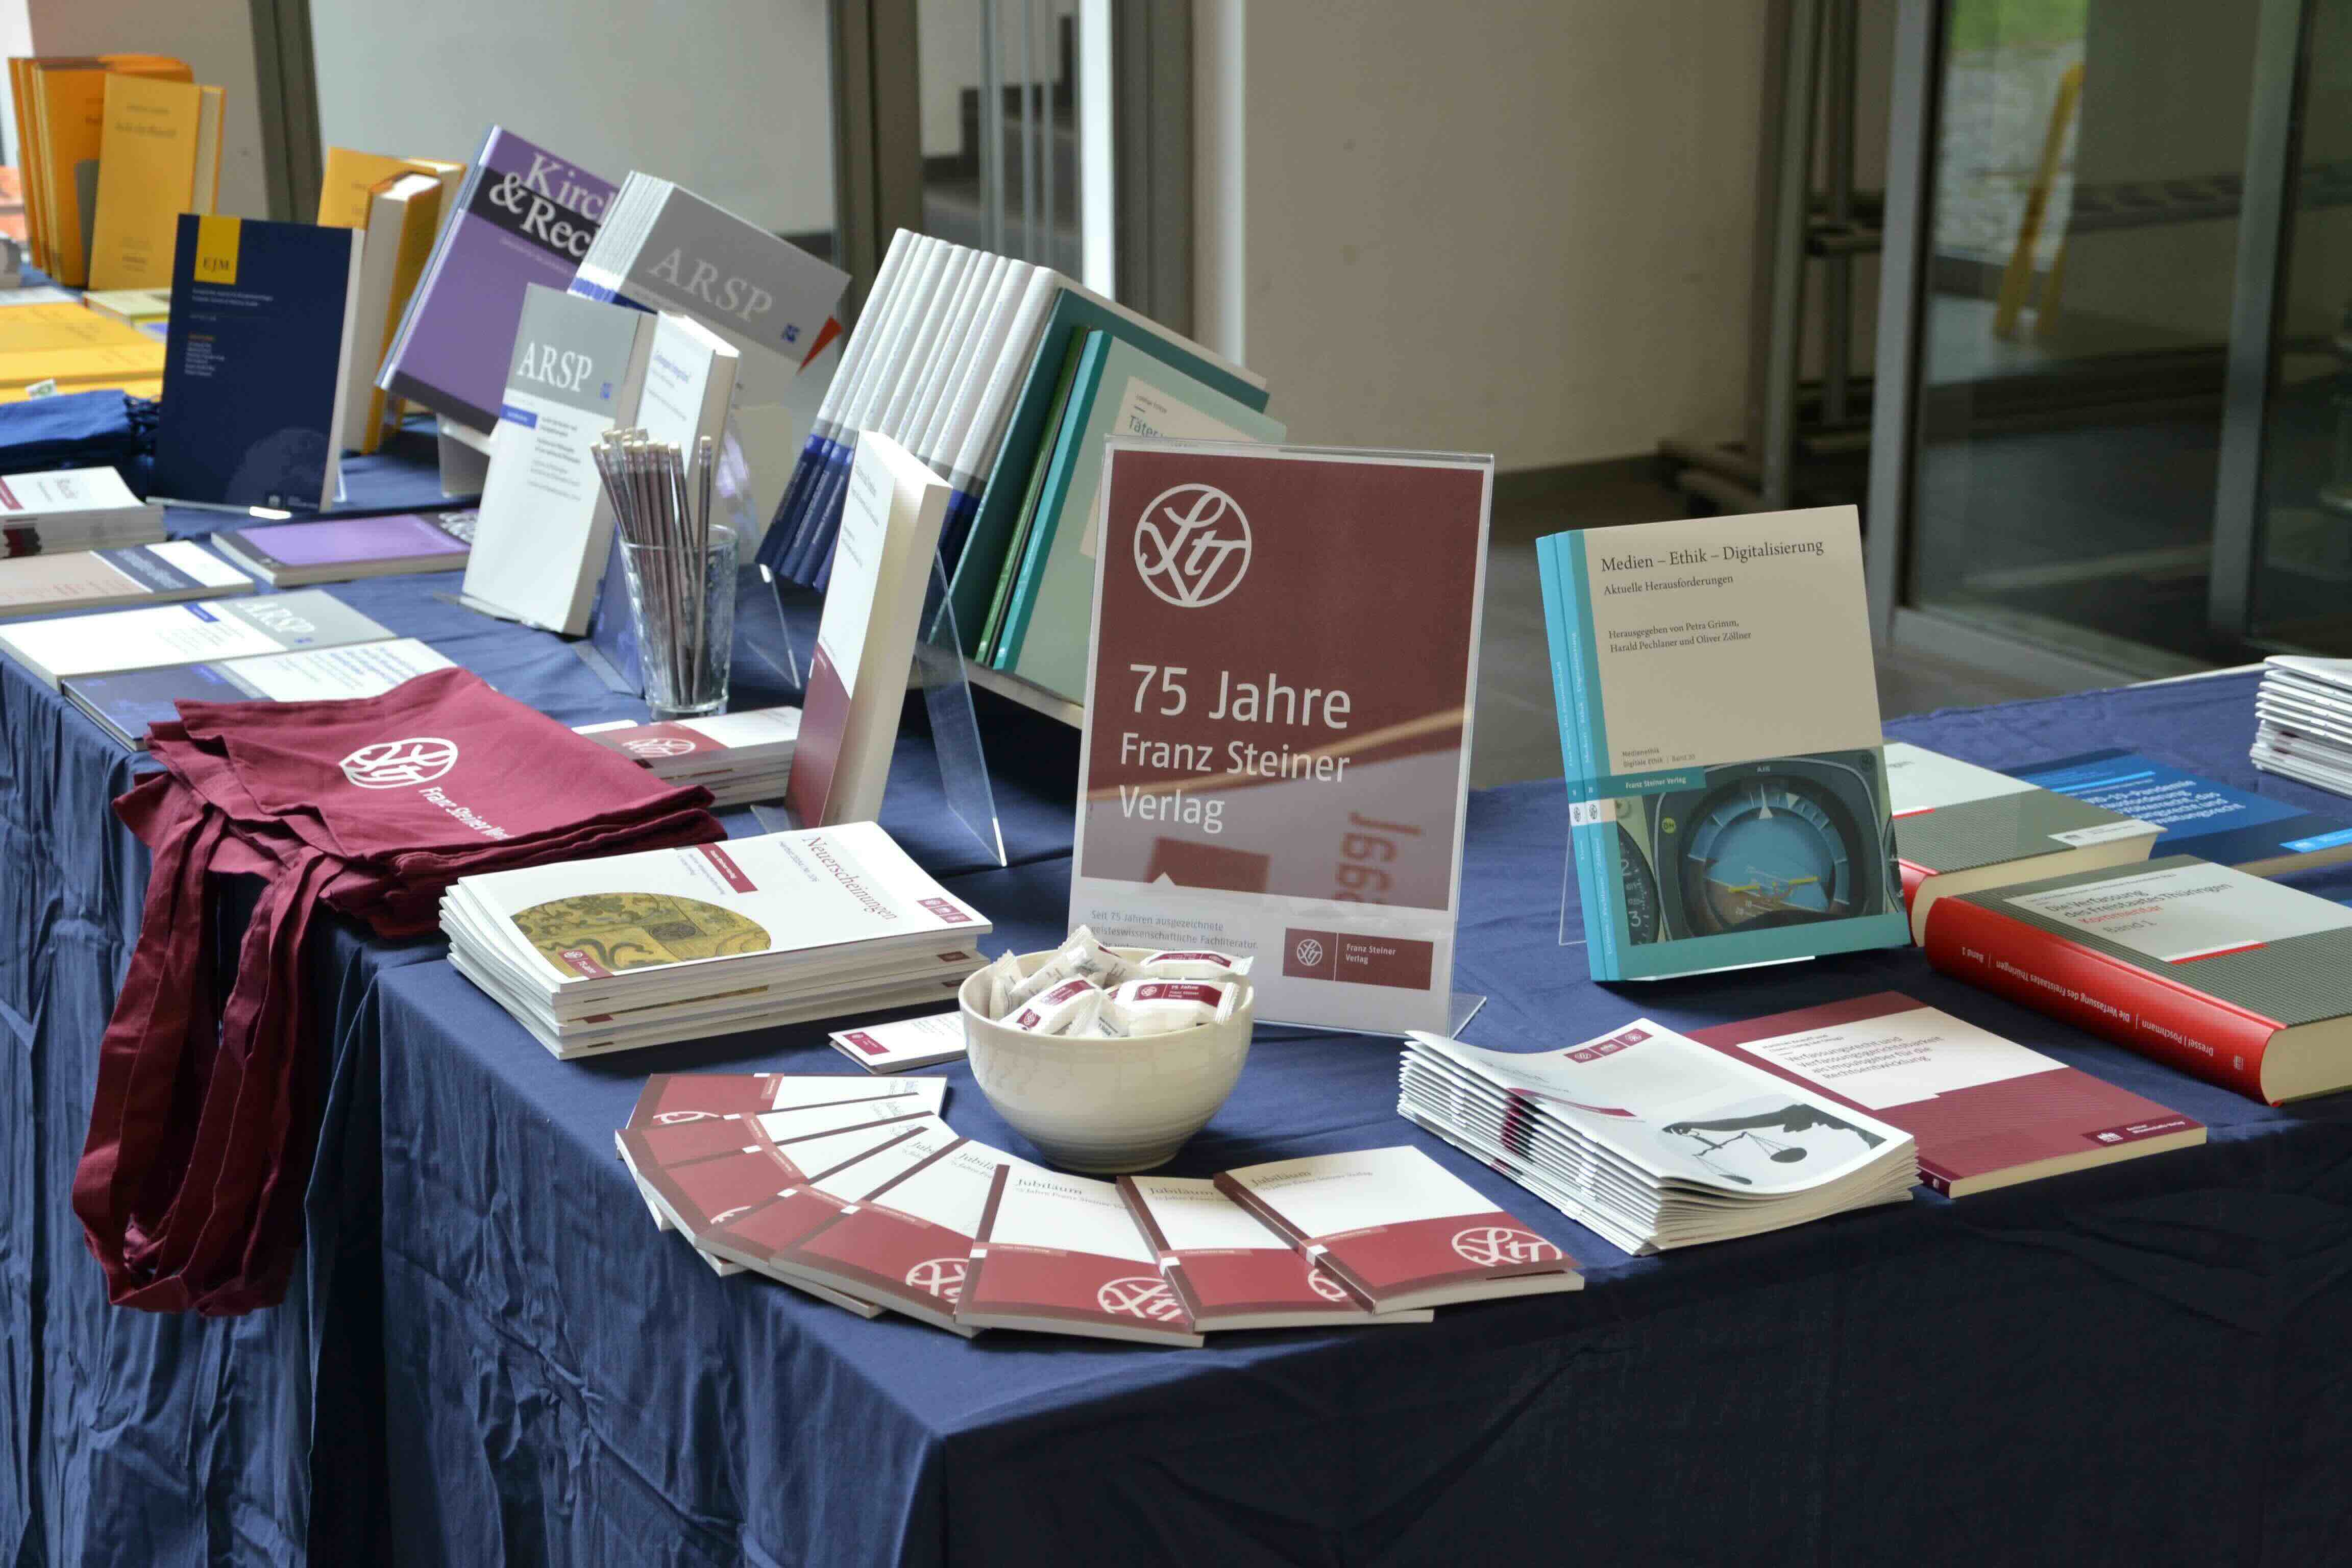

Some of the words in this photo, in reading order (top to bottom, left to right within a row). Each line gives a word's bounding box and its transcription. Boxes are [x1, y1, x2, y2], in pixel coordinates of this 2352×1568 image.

[202, 257, 229, 271] EJM
[647, 247, 773, 323] ARSP
[516, 342, 593, 393] ARSP
[1129, 415, 1158, 437] Täter
[1601, 555, 1654, 572] Medien
[1669, 548, 1707, 566] Ethik
[1723, 540, 1824, 563] Digitalisierung
[1604, 582, 1643, 596] Aktuelle
[1645, 575, 1734, 592] Herausforderungen
[1609, 626, 1668, 639] Herausgegeben
[1686, 622, 1706, 631] Petra
[1610, 642, 1637, 653] Harald
[1639, 639, 1677, 650] Pechlaner
[1679, 636, 1695, 646] und
[1696, 634, 1720, 644] Oliver
[1722, 631, 1751, 641] Zöllner
[1129, 664, 1187, 717] 75
[1208, 670, 1351, 729] Jahre
[1119, 731, 1213, 773] Franz
[1227, 740, 1351, 783] Steiner
[1644, 779, 1665, 787] Steiner
[1667, 776, 1686, 785] Verlag
[419, 787, 455, 807] Franz
[447, 807, 491, 831] Steiner
[1119, 785, 1226, 834] Verlag
[801, 837, 898, 919] Neuerscheinungen
[1091, 910, 1107, 920] Seit
[1111, 912, 1121, 920] 75
[1123, 913, 1154, 924] Jahren
[1156, 916, 1224, 932] ausgezeichnete
[1200, 935, 1258, 949] Fachliteratur.
[1346, 943, 1366, 952] Franz
[1368, 946, 1396, 955] Steiner
[1345, 954, 1368, 965] Verlag
[1967, 948, 1984, 963] Band
[1996, 960, 2029, 981] Thüringen
[2030, 974, 2066, 996] Freistaates
[2067, 989, 2079, 1000] des
[2080, 993, 2117, 1017] Verfassung
[2119, 1010, 2130, 1022] Die
[2142, 1020, 2183, 1044] Poschmann
[2188, 1039, 2214, 1057] Dressel
